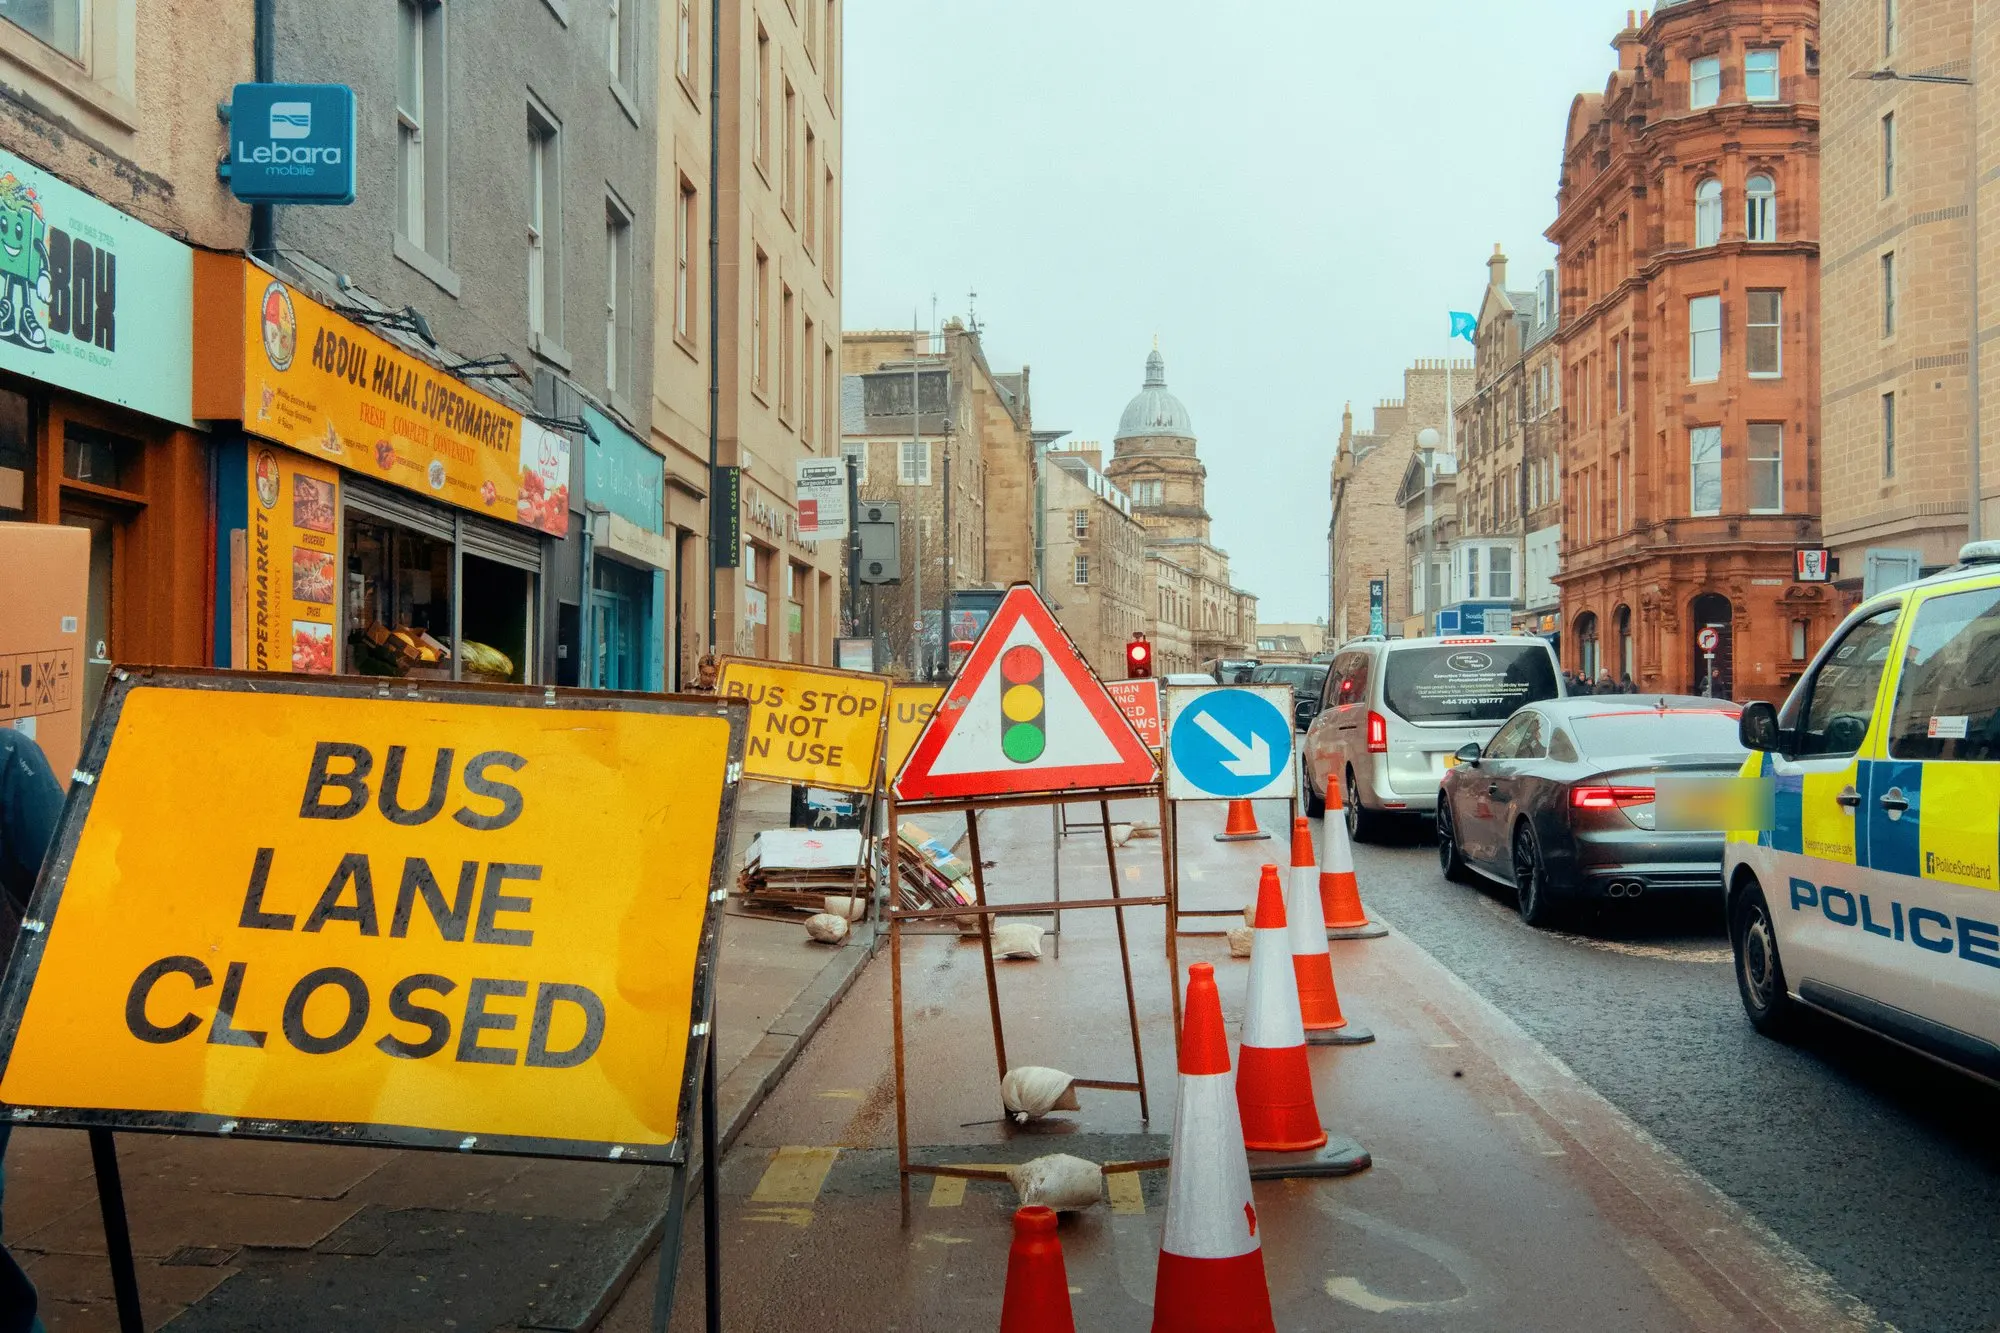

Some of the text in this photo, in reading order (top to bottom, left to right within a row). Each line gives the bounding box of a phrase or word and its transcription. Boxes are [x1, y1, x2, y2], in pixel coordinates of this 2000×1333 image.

[238, 140, 340, 164] Lebara
[266, 164, 314, 176] mobile
[49, 225, 116, 352] BOX
[312, 326, 367, 389] ABDUL
[372, 354, 418, 410] HALAL
[422, 379, 514, 453] SUPERMARKET
[360, 401, 476, 467] FRESH COMPLETE CONVENIENT
[730, 468, 738, 510] Mosque
[256, 508, 268, 670] UPERMARKET
[727, 680, 876, 718] BUS STOP
[766, 712, 828, 738] NOT
[749, 736, 843, 767] N USE
[298, 741, 529, 830] BUS
[1804, 838, 1852, 856] Keeping people safe
[1936, 858, 1992, 880] PoliceScotland
[238, 848, 542, 946] LANE
[1789, 876, 2000, 969] POLICE
[125, 954, 606, 1069] CLOSED
